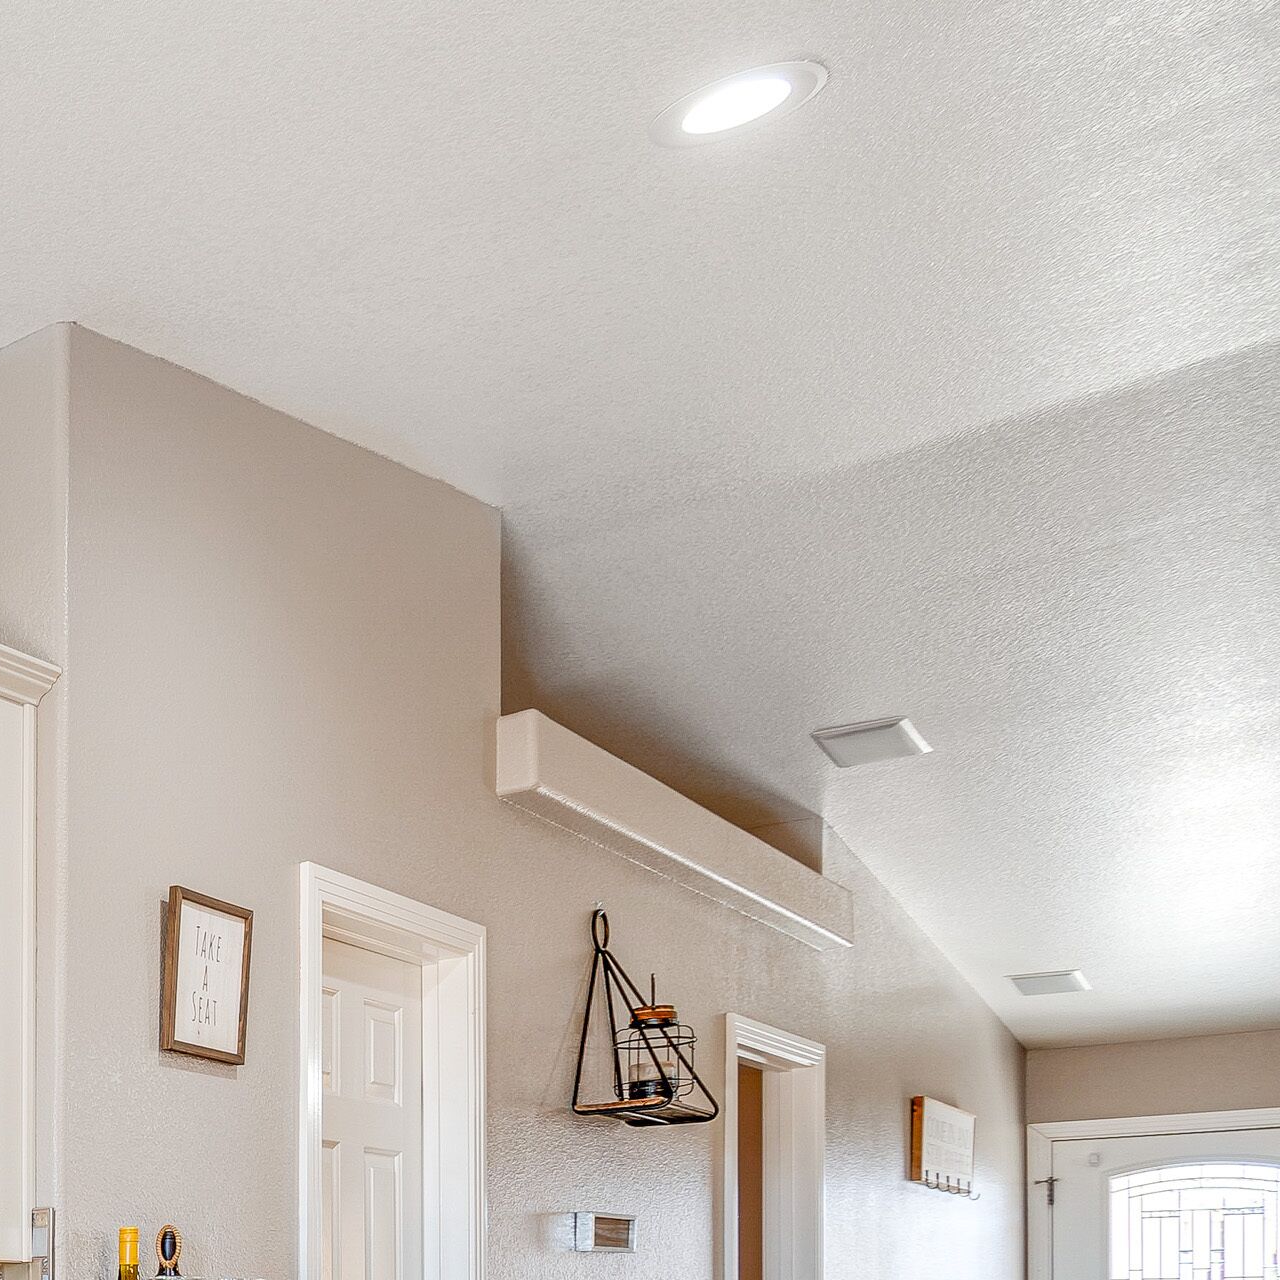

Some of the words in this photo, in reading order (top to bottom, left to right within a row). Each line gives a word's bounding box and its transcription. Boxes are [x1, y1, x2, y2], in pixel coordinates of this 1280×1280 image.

[195, 925, 222, 963] TAKE
[202, 965, 209, 992] A
[191, 991, 218, 1026] SEAT
